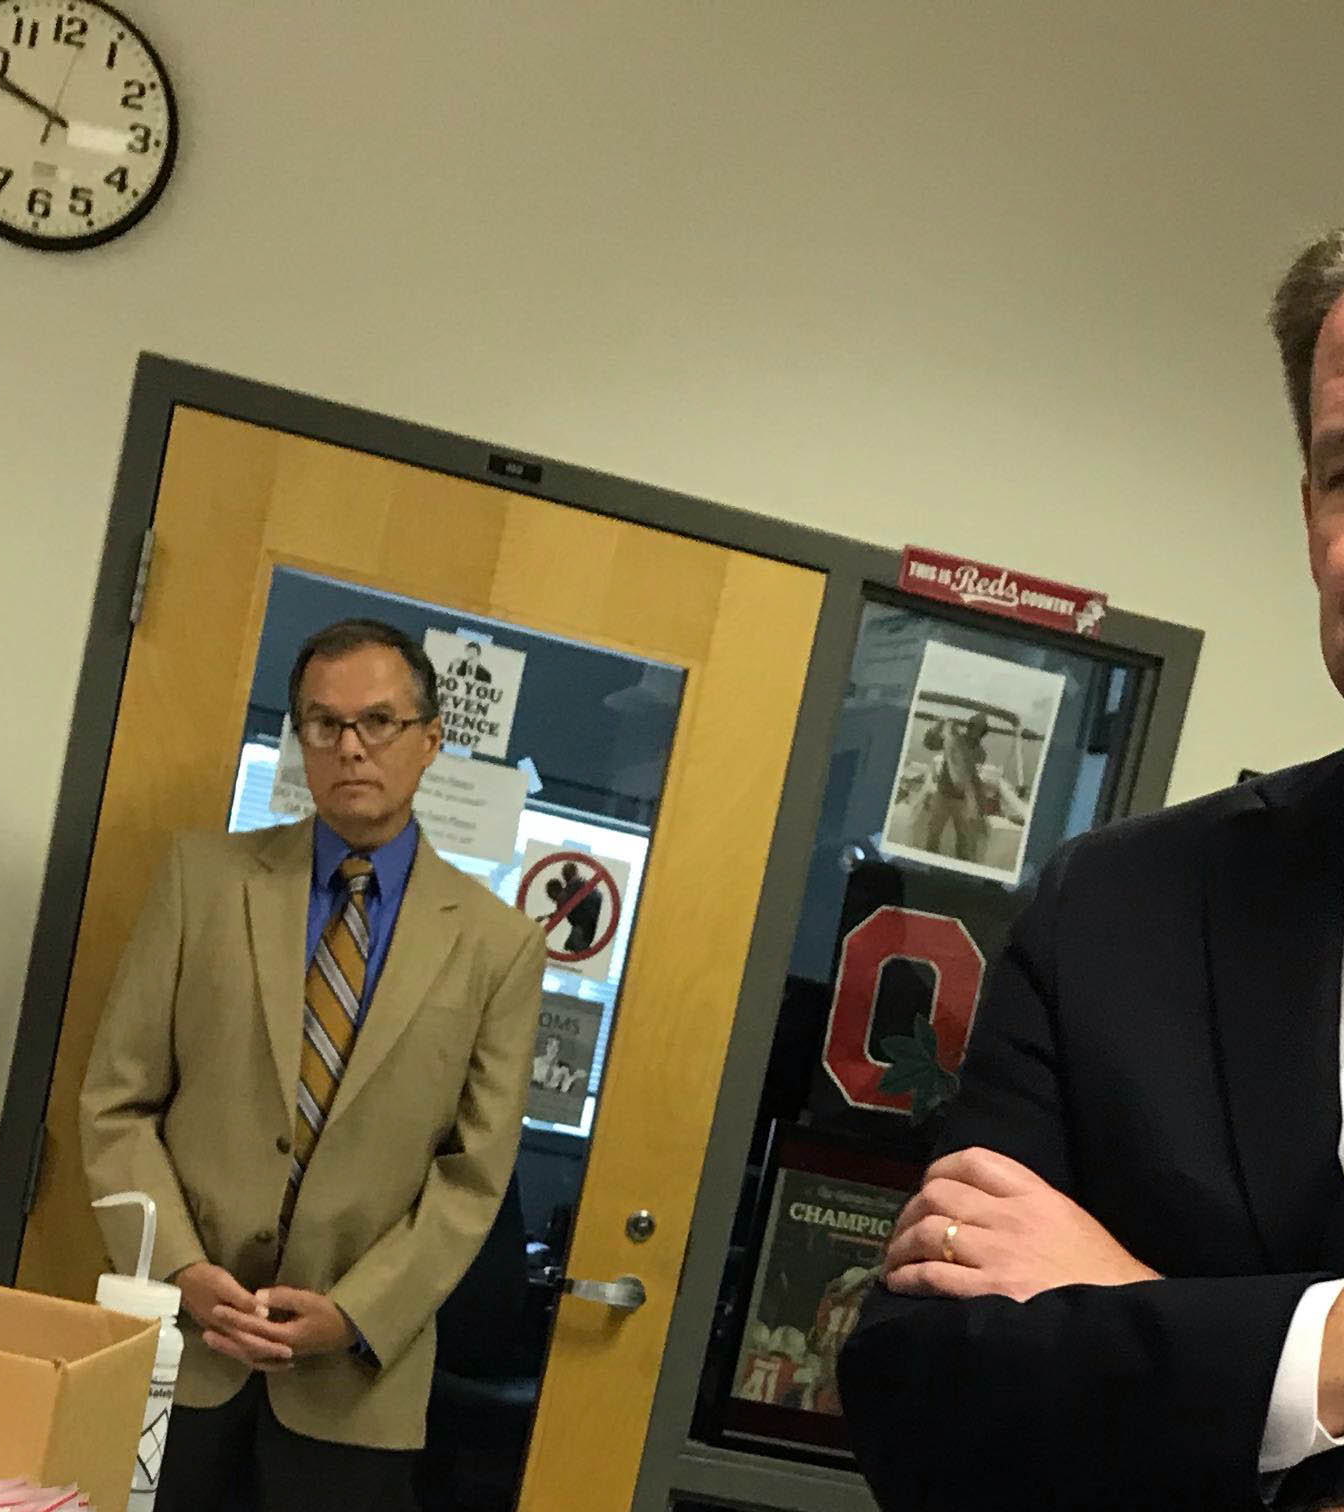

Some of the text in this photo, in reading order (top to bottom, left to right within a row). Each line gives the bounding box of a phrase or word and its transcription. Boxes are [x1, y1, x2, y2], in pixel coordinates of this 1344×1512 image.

[12, 17, 40, 49] 11
[53, 13, 88, 48] 12
[106, 41, 117, 69] 1
[120, 79, 147, 111] 2
[126, 122, 152, 154] 3
[103, 165, 131, 194] 4
[27, 187, 53, 219] 6
[68, 186, 94, 217] 5
[951, 565, 1019, 605] Reds
[440, 693, 490, 717] EVEN
[465, 681, 504, 704] YOU
[442, 711, 500, 737] IENCE
[445, 729, 481, 746] RO?
[539, 1012, 580, 1036] OMS
